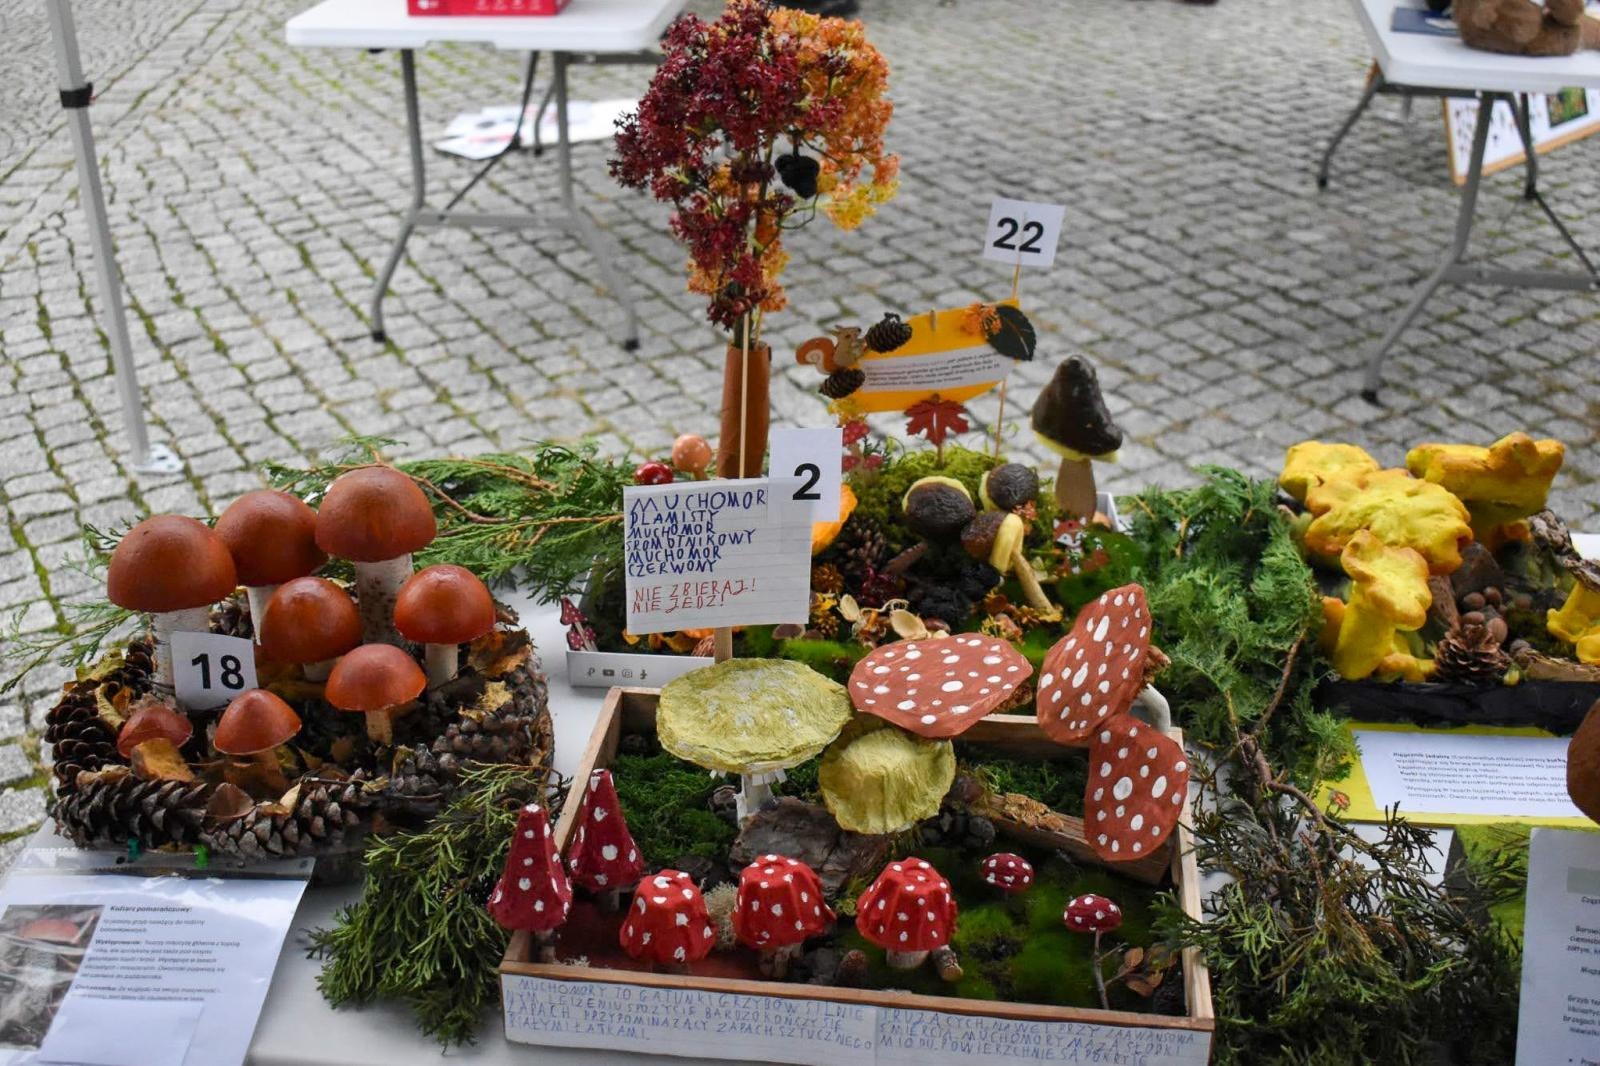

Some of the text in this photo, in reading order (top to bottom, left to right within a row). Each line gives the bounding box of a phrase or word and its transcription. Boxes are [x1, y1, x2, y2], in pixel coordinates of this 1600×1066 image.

[992, 217, 1044, 254] 22
[792, 463, 821, 501] 2
[631, 489, 766, 512] MUCHOMOR
[625, 529, 756, 551] SROMOTNIKOWY
[627, 522, 716, 540] MUCHOMOR
[628, 545, 722, 564] MUCHOMOR
[628, 559, 717, 577] CZERWONY
[635, 586, 662, 602] NIE
[632, 600, 662, 614] NIE
[191, 653, 245, 690] 18
[614, 987, 631, 1000] TO
[705, 1007, 760, 1022] BARDZO
